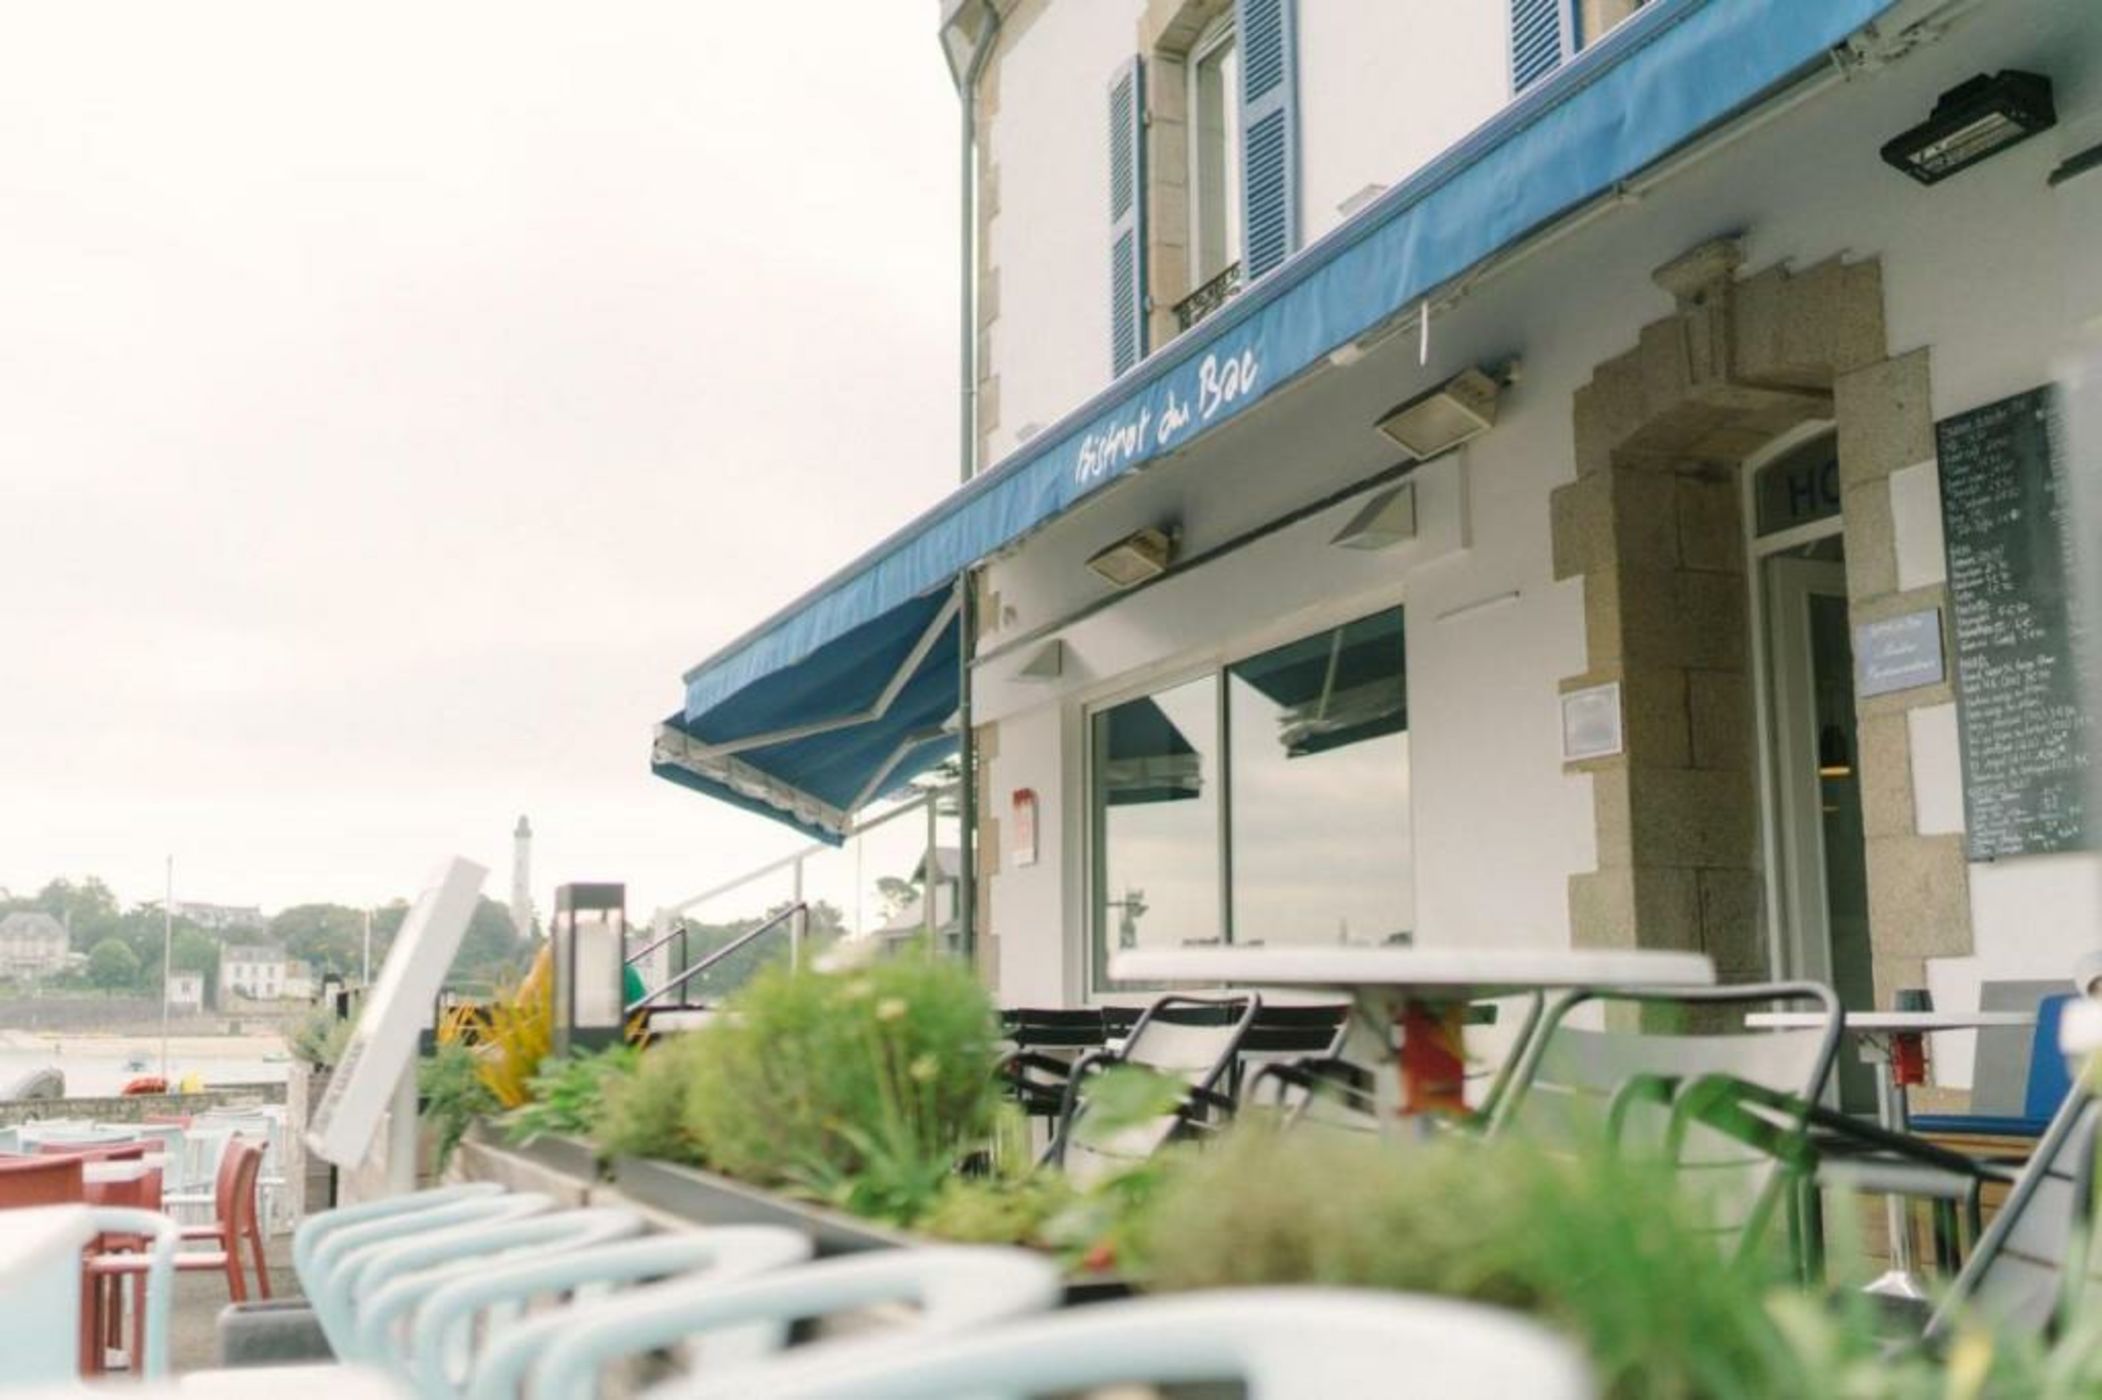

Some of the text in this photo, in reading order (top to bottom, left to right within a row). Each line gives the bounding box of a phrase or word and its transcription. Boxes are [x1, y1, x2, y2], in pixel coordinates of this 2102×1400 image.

[1075, 348, 1259, 485] Bistrot du Bac
